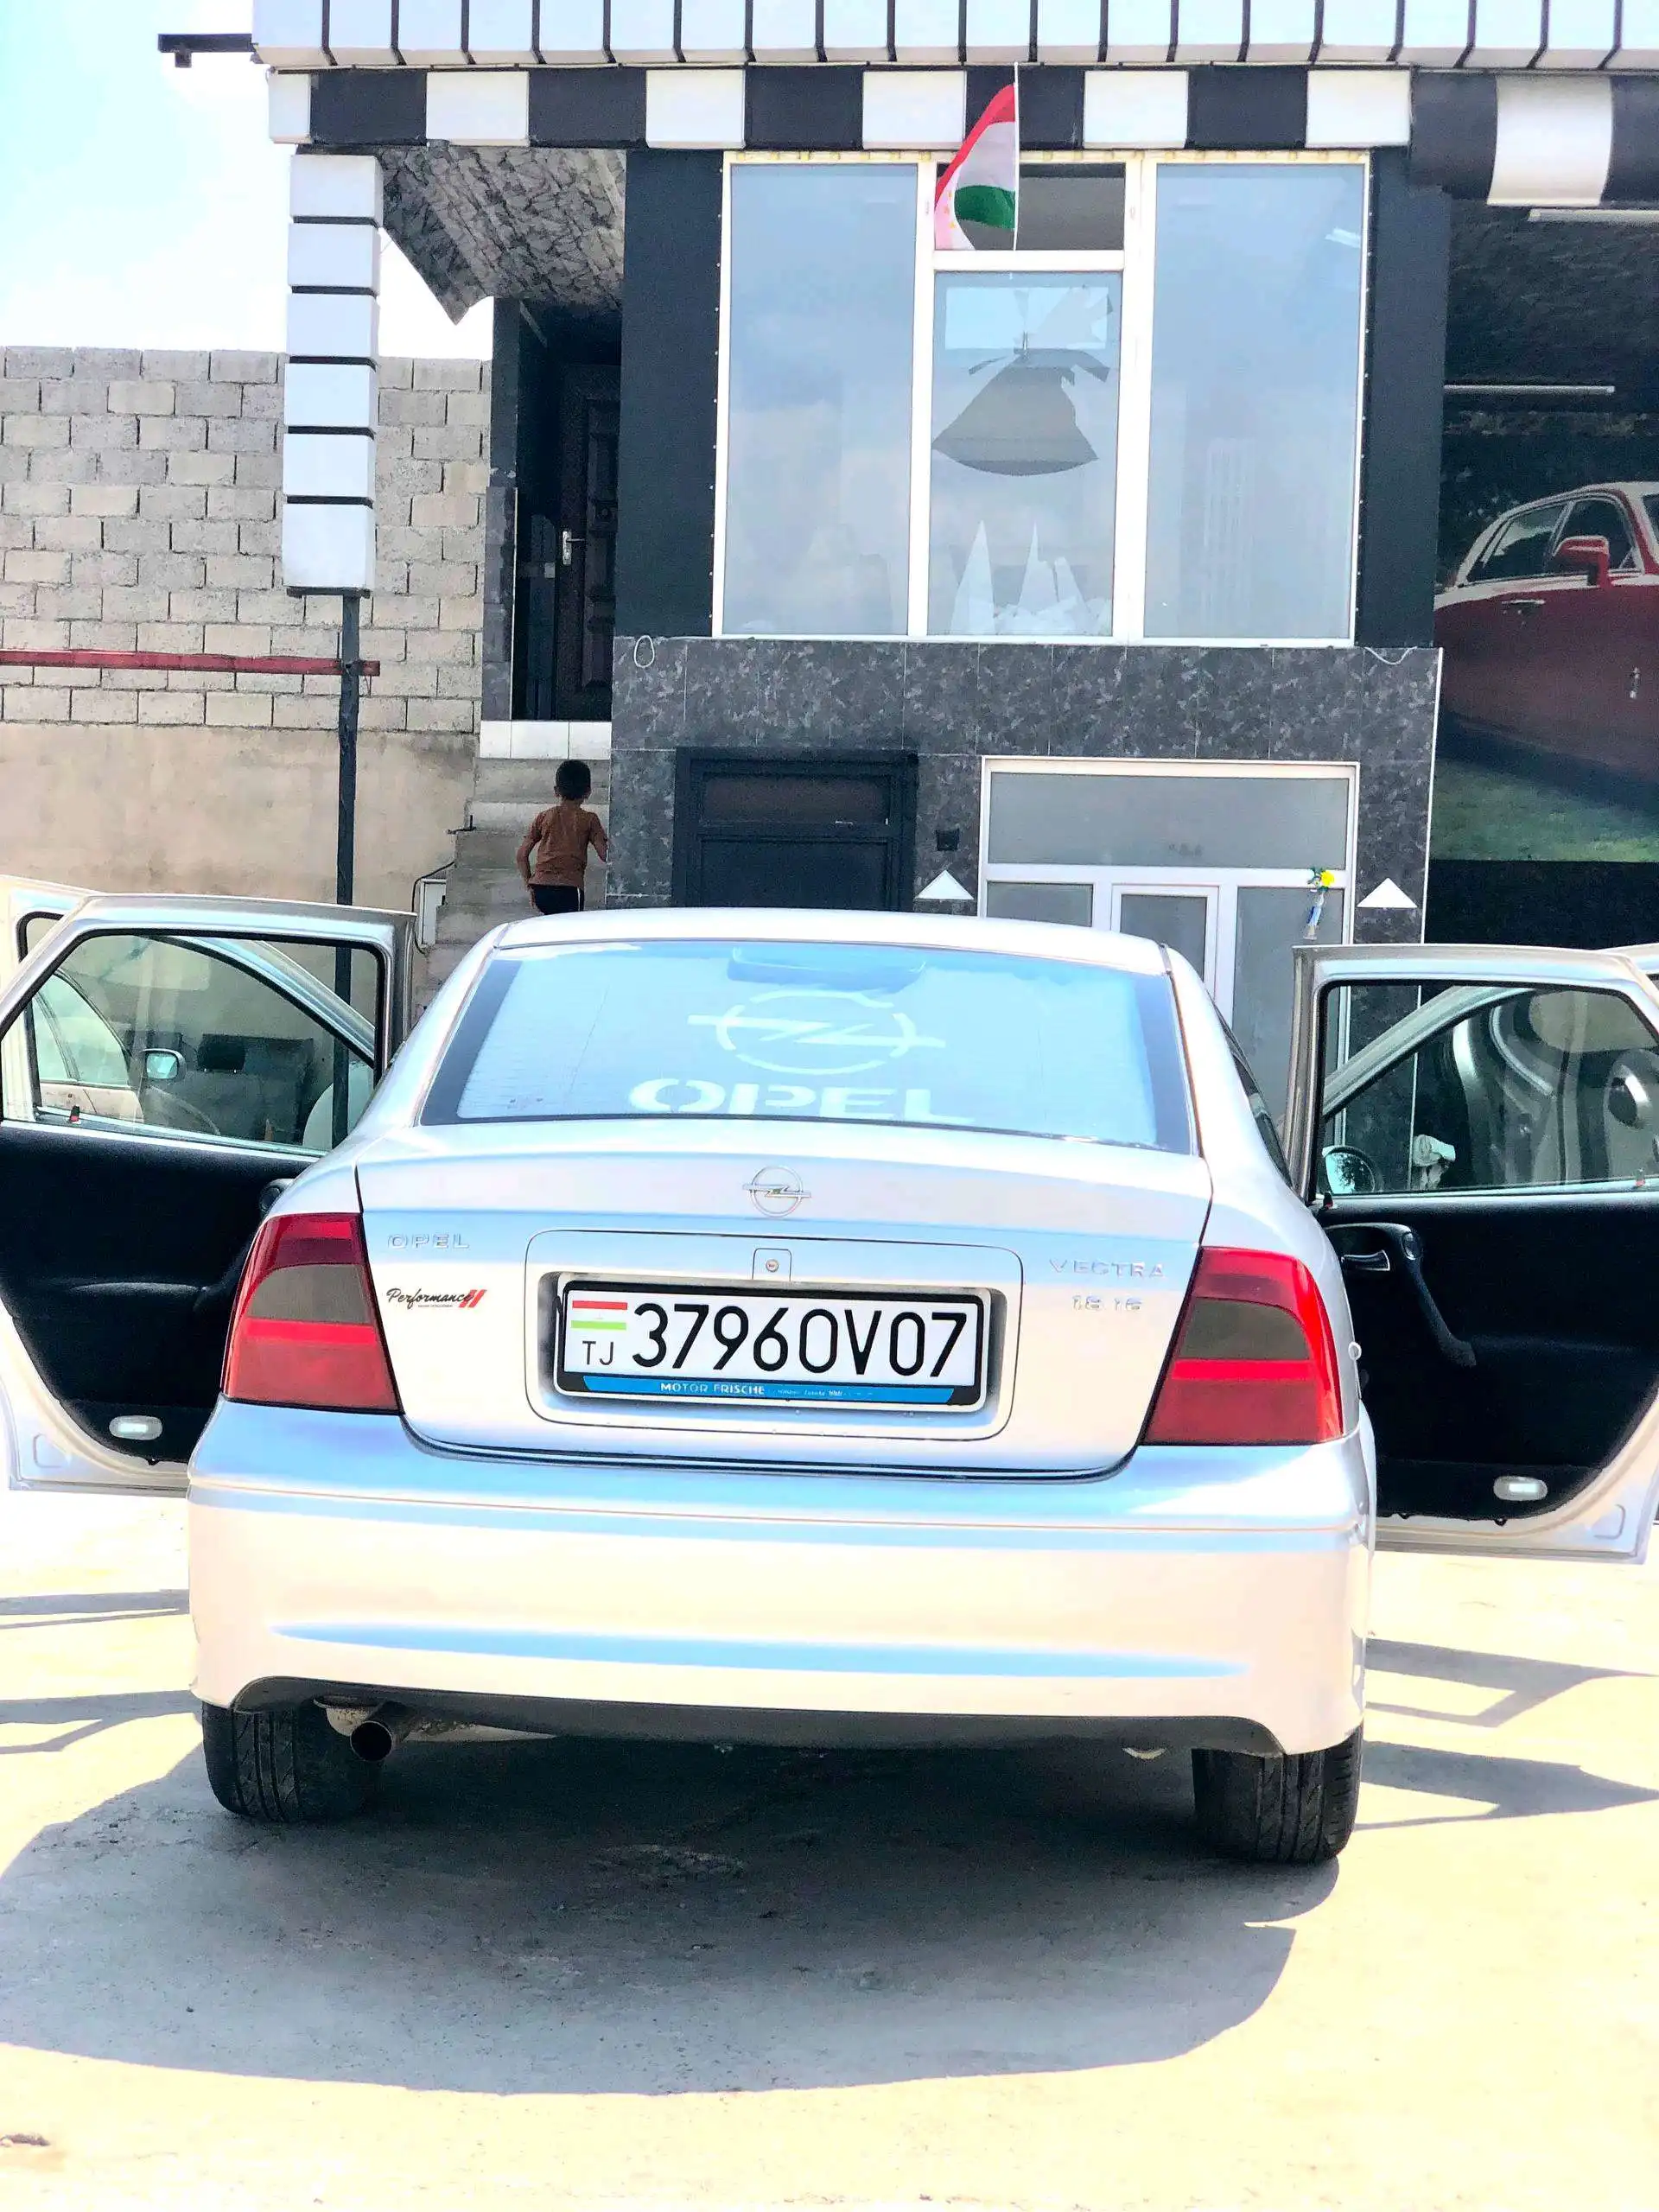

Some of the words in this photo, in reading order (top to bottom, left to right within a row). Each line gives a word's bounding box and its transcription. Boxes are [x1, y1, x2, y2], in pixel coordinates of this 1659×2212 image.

[628, 1077, 976, 1122] OPEL
[388, 1233, 470, 1249] OPEL
[1048, 1258, 1166, 1278] VECTRA
[385, 1287, 474, 1310] Performance
[582, 1339, 615, 1366] TJ
[660, 1382, 709, 1394] MOTOR
[713, 1383, 765, 1395] FRISCHE
